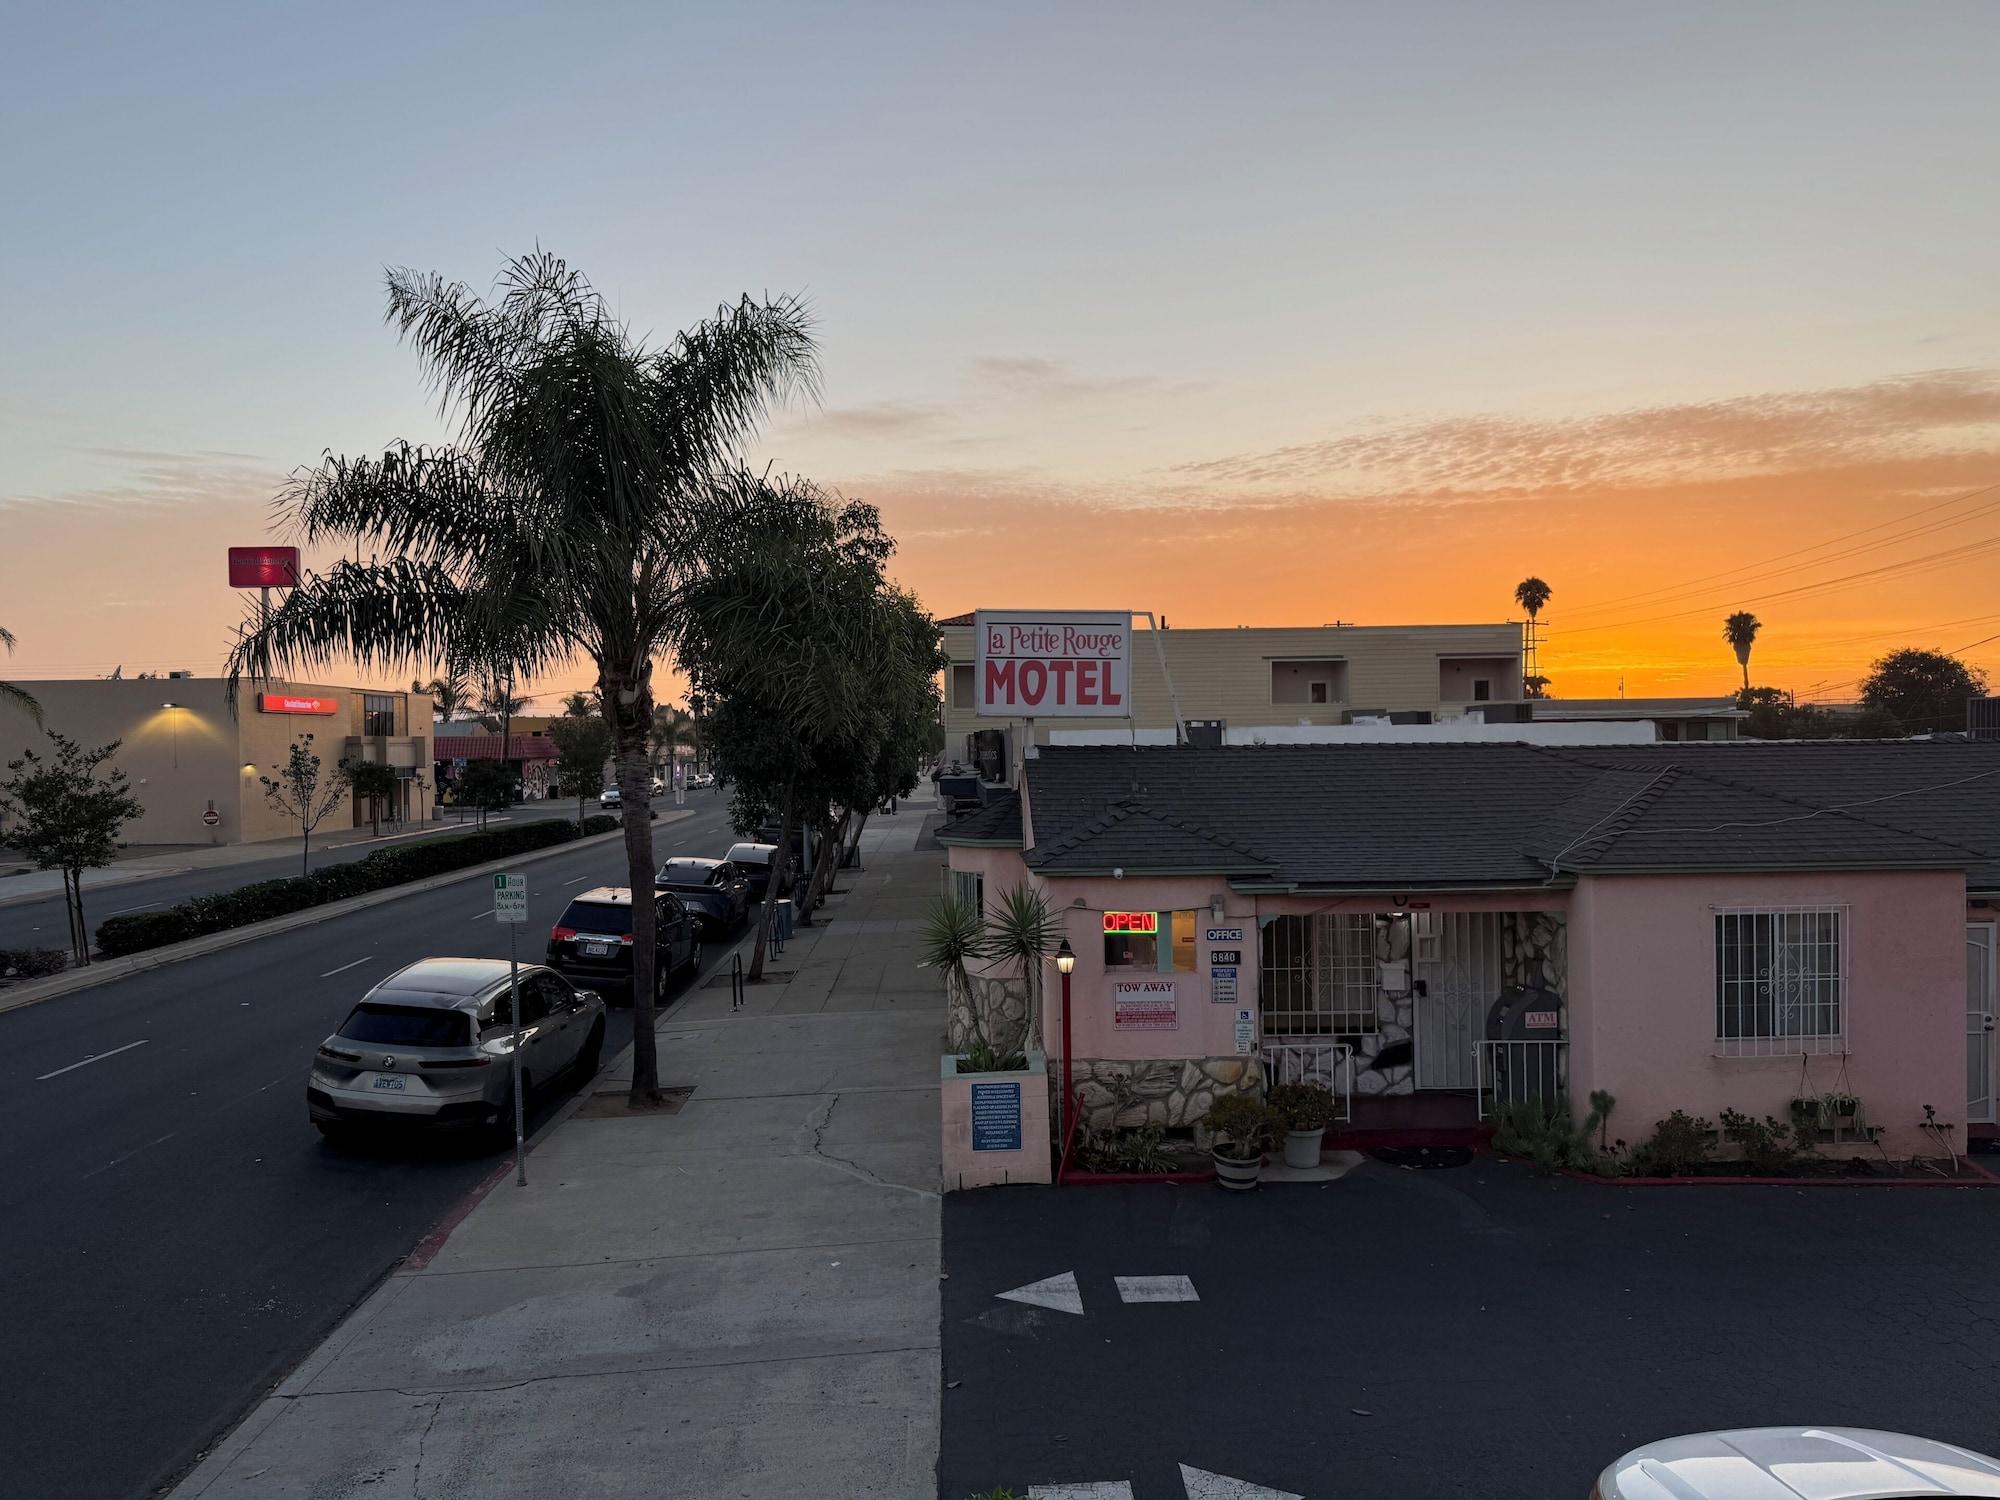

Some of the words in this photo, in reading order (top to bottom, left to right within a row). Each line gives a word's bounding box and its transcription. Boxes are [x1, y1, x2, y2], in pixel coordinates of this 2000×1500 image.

[986, 625, 1006, 655] La
[1009, 626, 1060, 655] Petite
[1063, 626, 1122, 657] Rouge
[985, 660, 1122, 706] MOTEL
[507, 878, 524, 887] HOUR
[497, 891, 525, 901] PARKING
[1103, 913, 1155, 931] OPEN
[1207, 930, 1242, 940] OFFICE
[1212, 952, 1236, 963] 6840
[1117, 983, 1141, 993] TOW
[1143, 983, 1173, 993] AWAY
[1528, 1013, 1554, 1023] ATM
